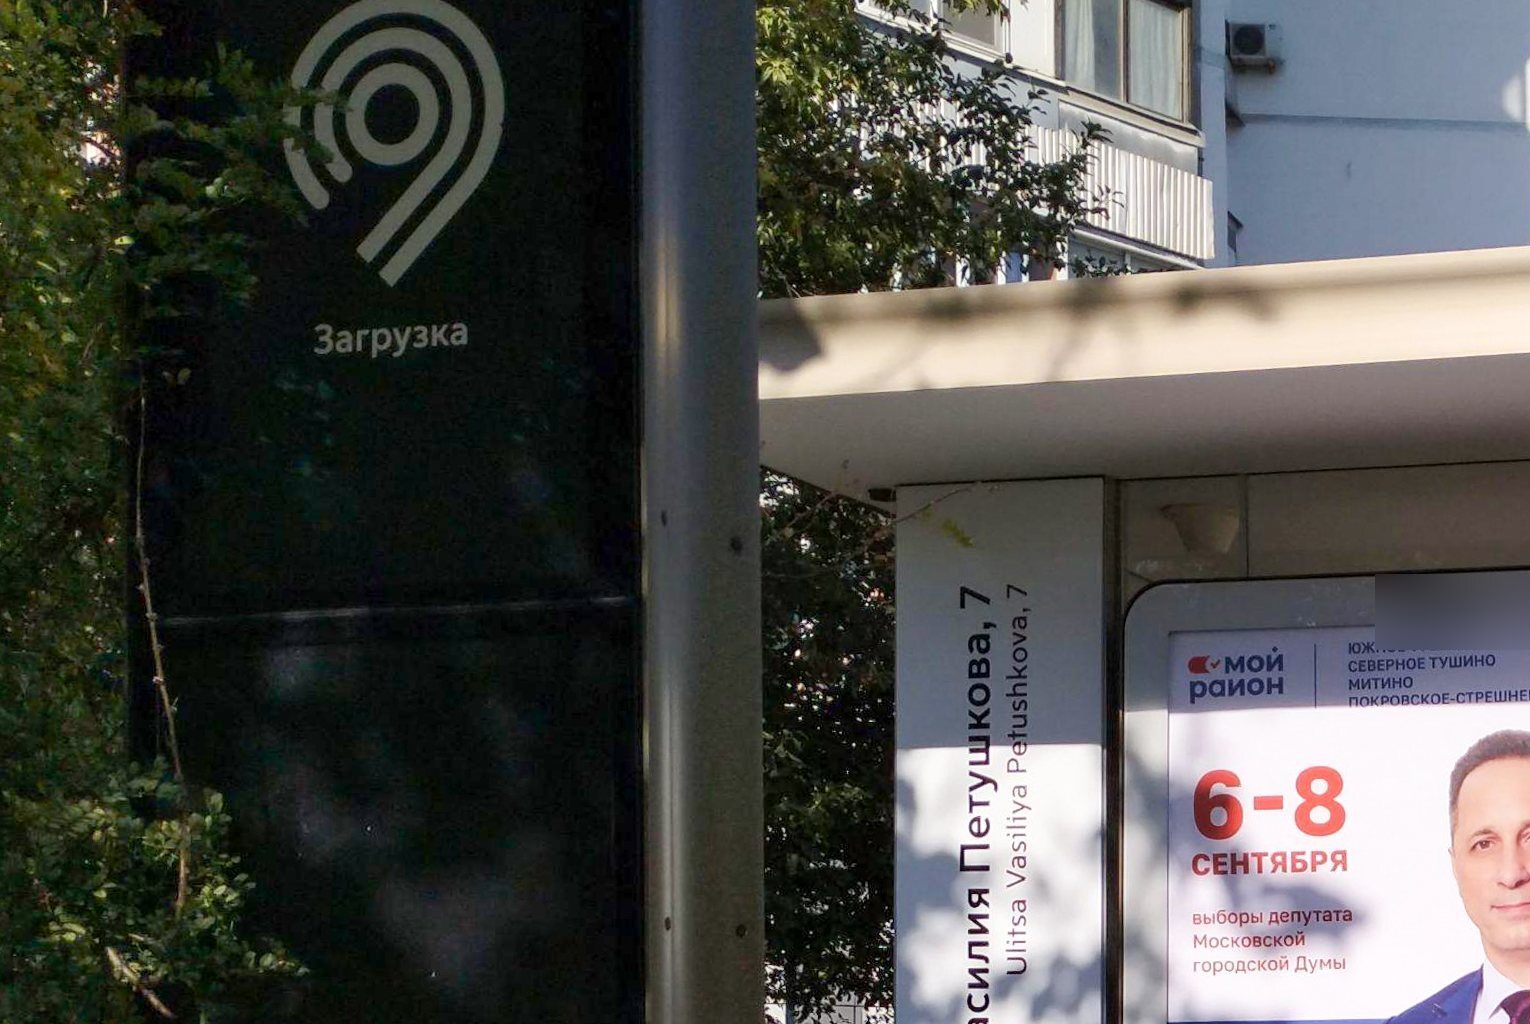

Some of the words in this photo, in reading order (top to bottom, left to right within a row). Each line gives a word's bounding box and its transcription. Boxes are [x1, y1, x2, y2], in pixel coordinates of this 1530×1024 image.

[313, 322, 469, 358] Загрузка
[959, 586, 991, 609] 7
[1005, 583, 1028, 600] 7
[1224, 646, 1284, 673] мой
[1348, 657, 1425, 673] СЕВЕРНОЕ
[1428, 653, 1496, 670] ТУШИНО
[1005, 606, 1032, 773] Petushkova,
[1348, 676, 1414, 691] МИТИНО
[958, 617, 998, 872] Петушкова,
[1005, 785, 1033, 885] Vasiliya
[1191, 849, 1349, 877] СЕНТЯБРЯ
[1192, 908, 1264, 927] выборы
[1268, 907, 1353, 926] депутата
[1005, 899, 1029, 976] Ulitsa
[1193, 931, 1307, 950] Московской
[1193, 955, 1290, 974] городской
[1294, 954, 1347, 974] Думы
